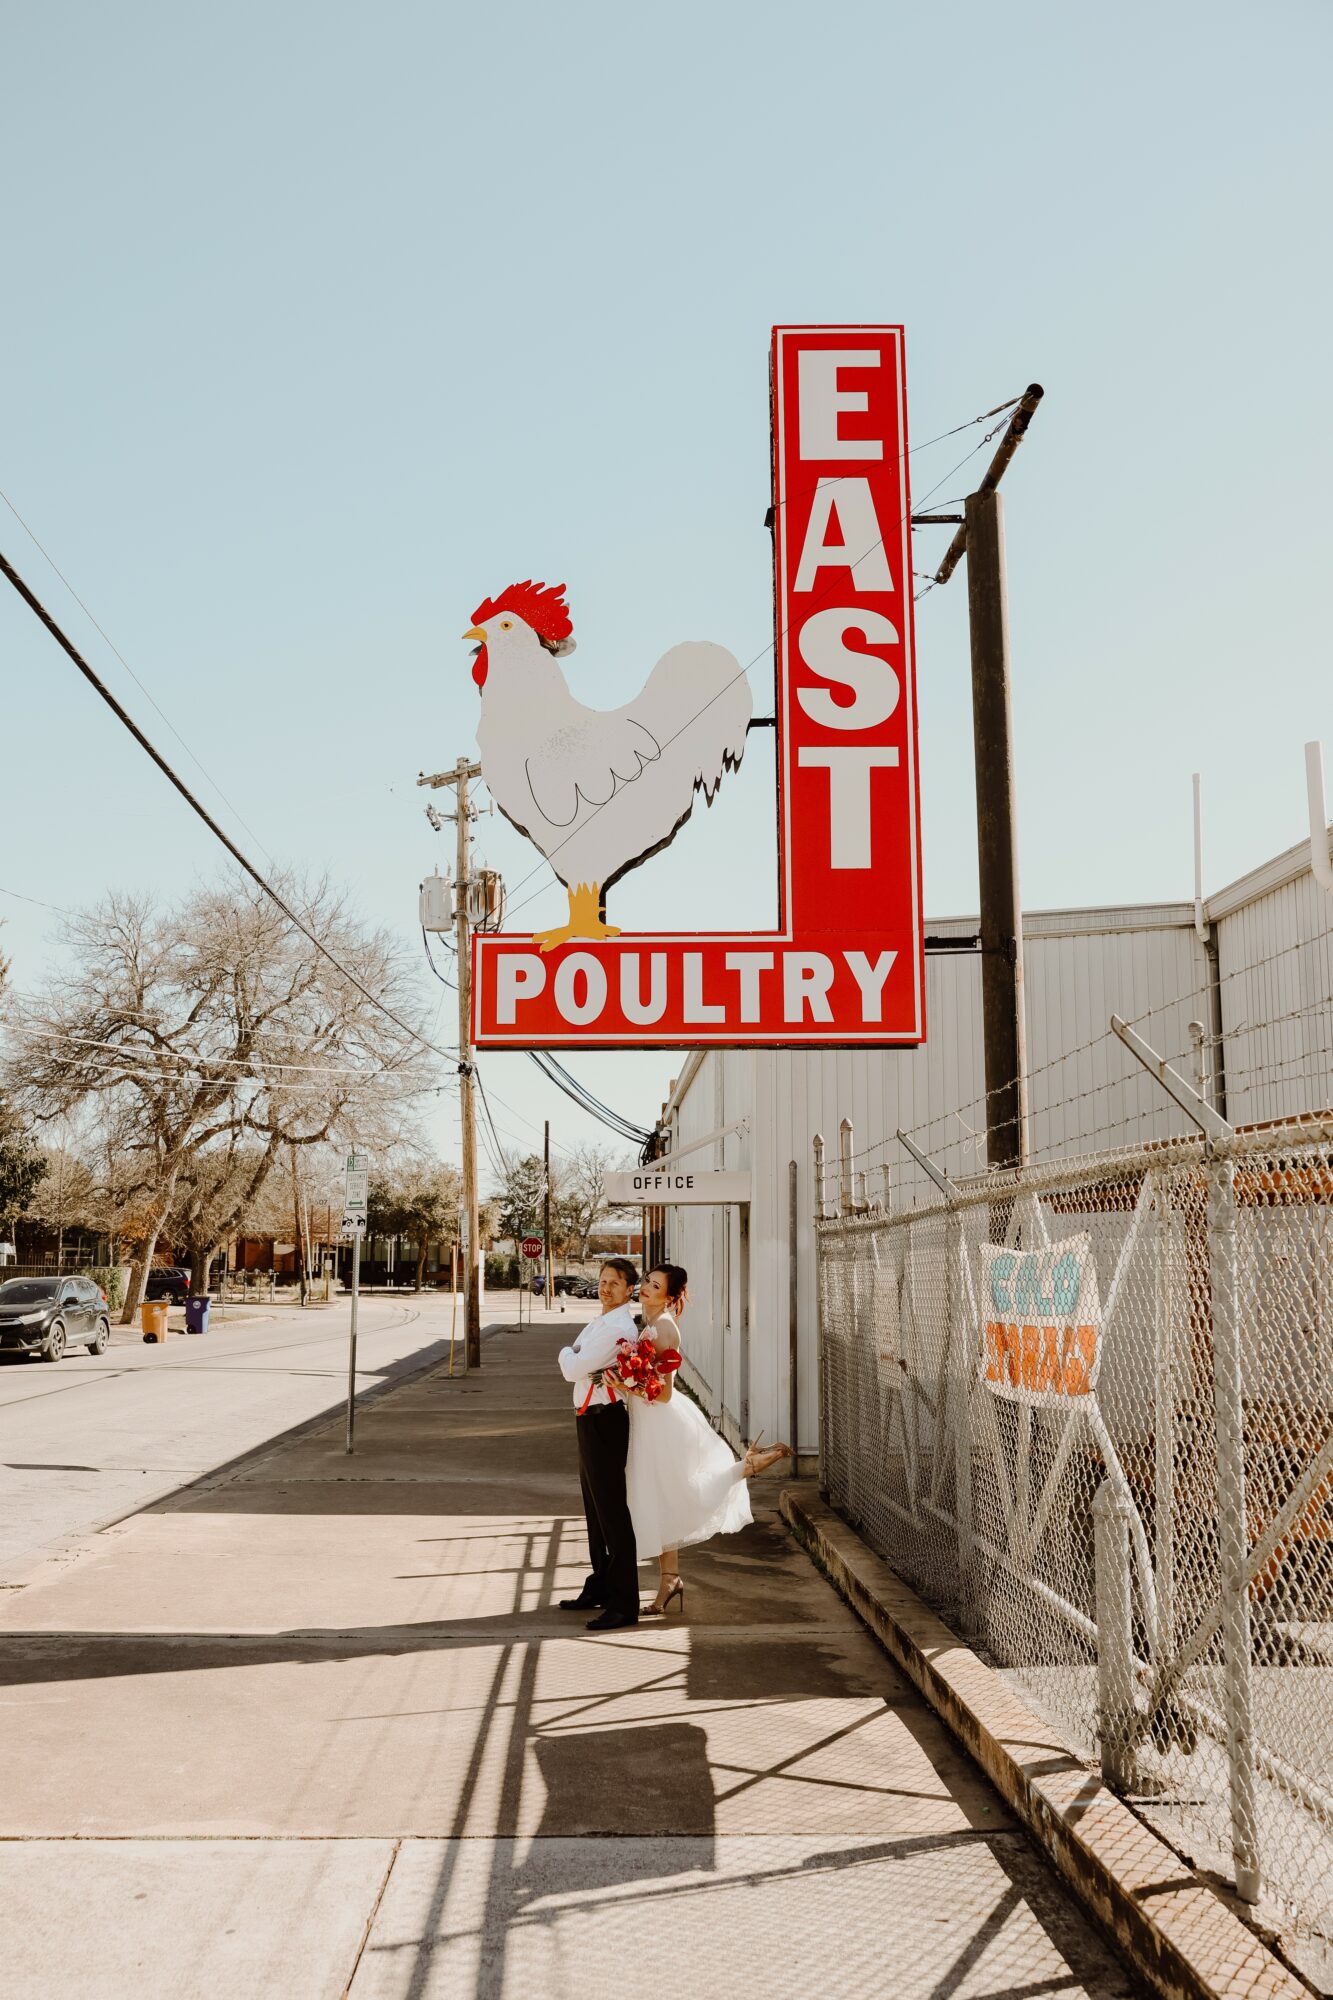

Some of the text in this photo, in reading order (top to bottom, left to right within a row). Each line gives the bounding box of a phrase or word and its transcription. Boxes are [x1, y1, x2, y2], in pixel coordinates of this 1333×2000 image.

[793, 349, 901, 870] EAST
[496, 949, 898, 1026] POULTRY
[633, 1176, 694, 1190] OFFICE
[523, 1243, 542, 1252] STOP
